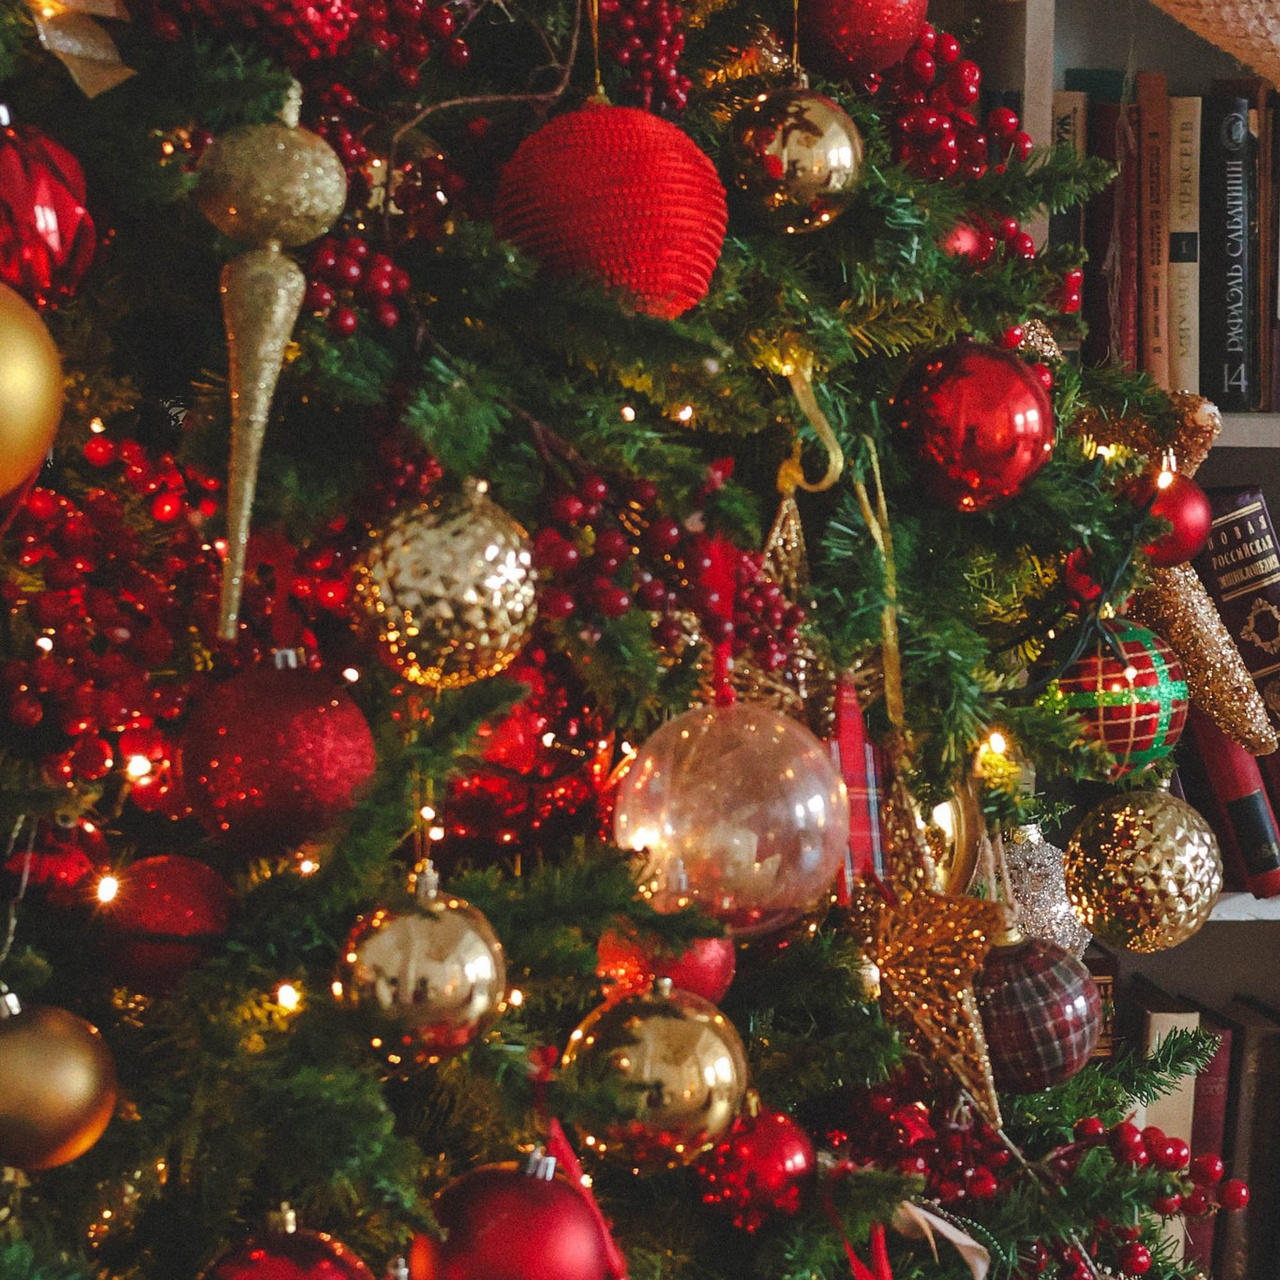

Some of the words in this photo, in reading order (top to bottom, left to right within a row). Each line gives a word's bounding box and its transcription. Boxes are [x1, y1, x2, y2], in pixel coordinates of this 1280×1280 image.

[1177, 121, 1194, 222] АЛЕКСЕЕВ
[1224, 159, 1246, 257] САБАТИНИ
[1225, 263, 1245, 353] РАФАЭЛЬ
[1222, 362, 1249, 393] 14
[1208, 514, 1268, 551] НОВАЯ
[1211, 535, 1274, 570] РОССИЙСКАЯ
